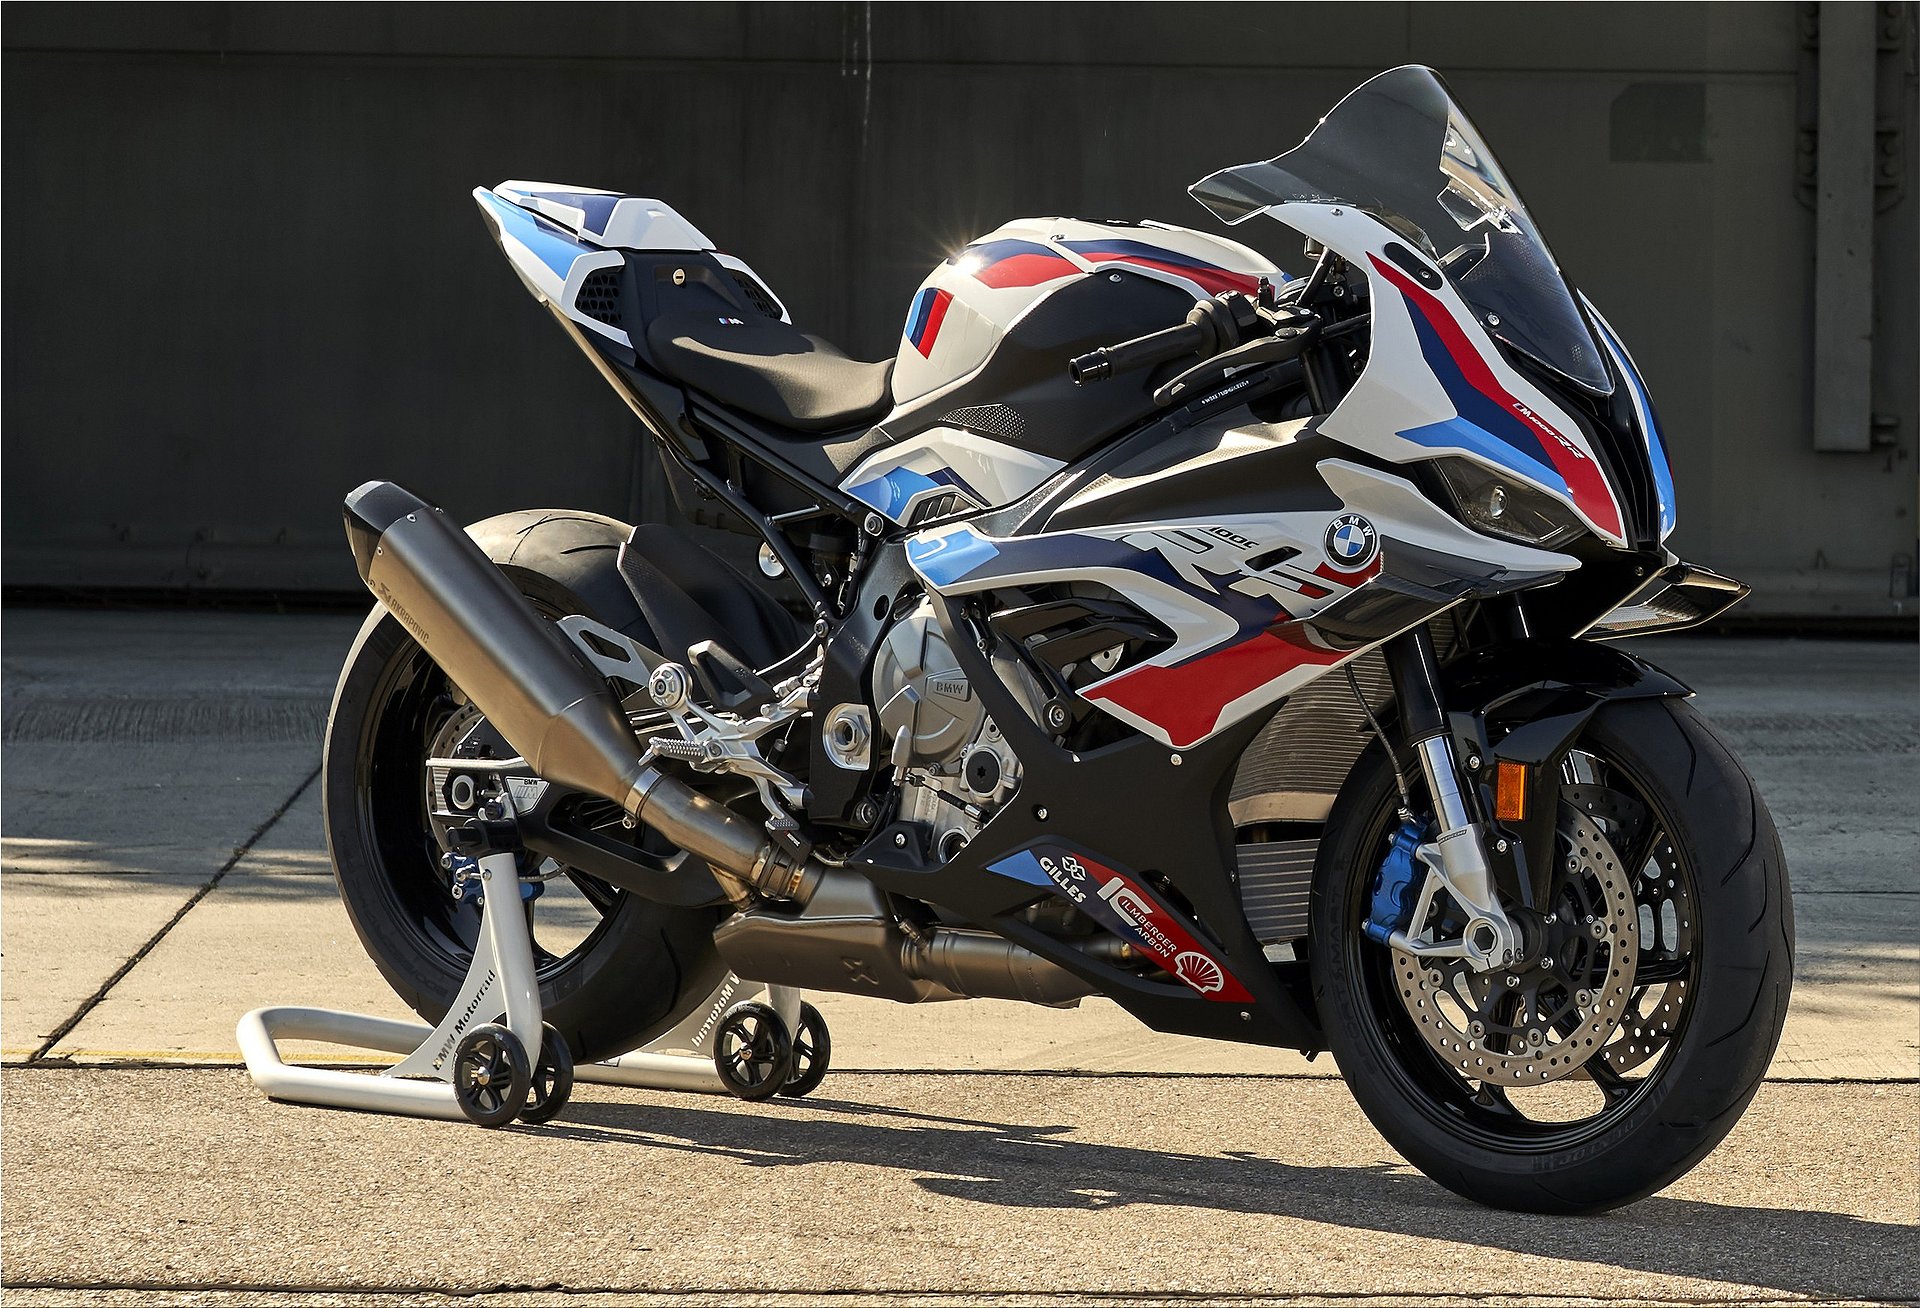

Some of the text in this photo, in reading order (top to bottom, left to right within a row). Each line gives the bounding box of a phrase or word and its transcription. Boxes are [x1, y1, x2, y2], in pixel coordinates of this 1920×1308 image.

[1333, 516, 1373, 537] BMW
[936, 682, 964, 695] BMW
[1040, 857, 1087, 903] GILLES
[1121, 900, 1177, 952] ILMBERGER
[454, 969, 496, 1035] Motorrad
